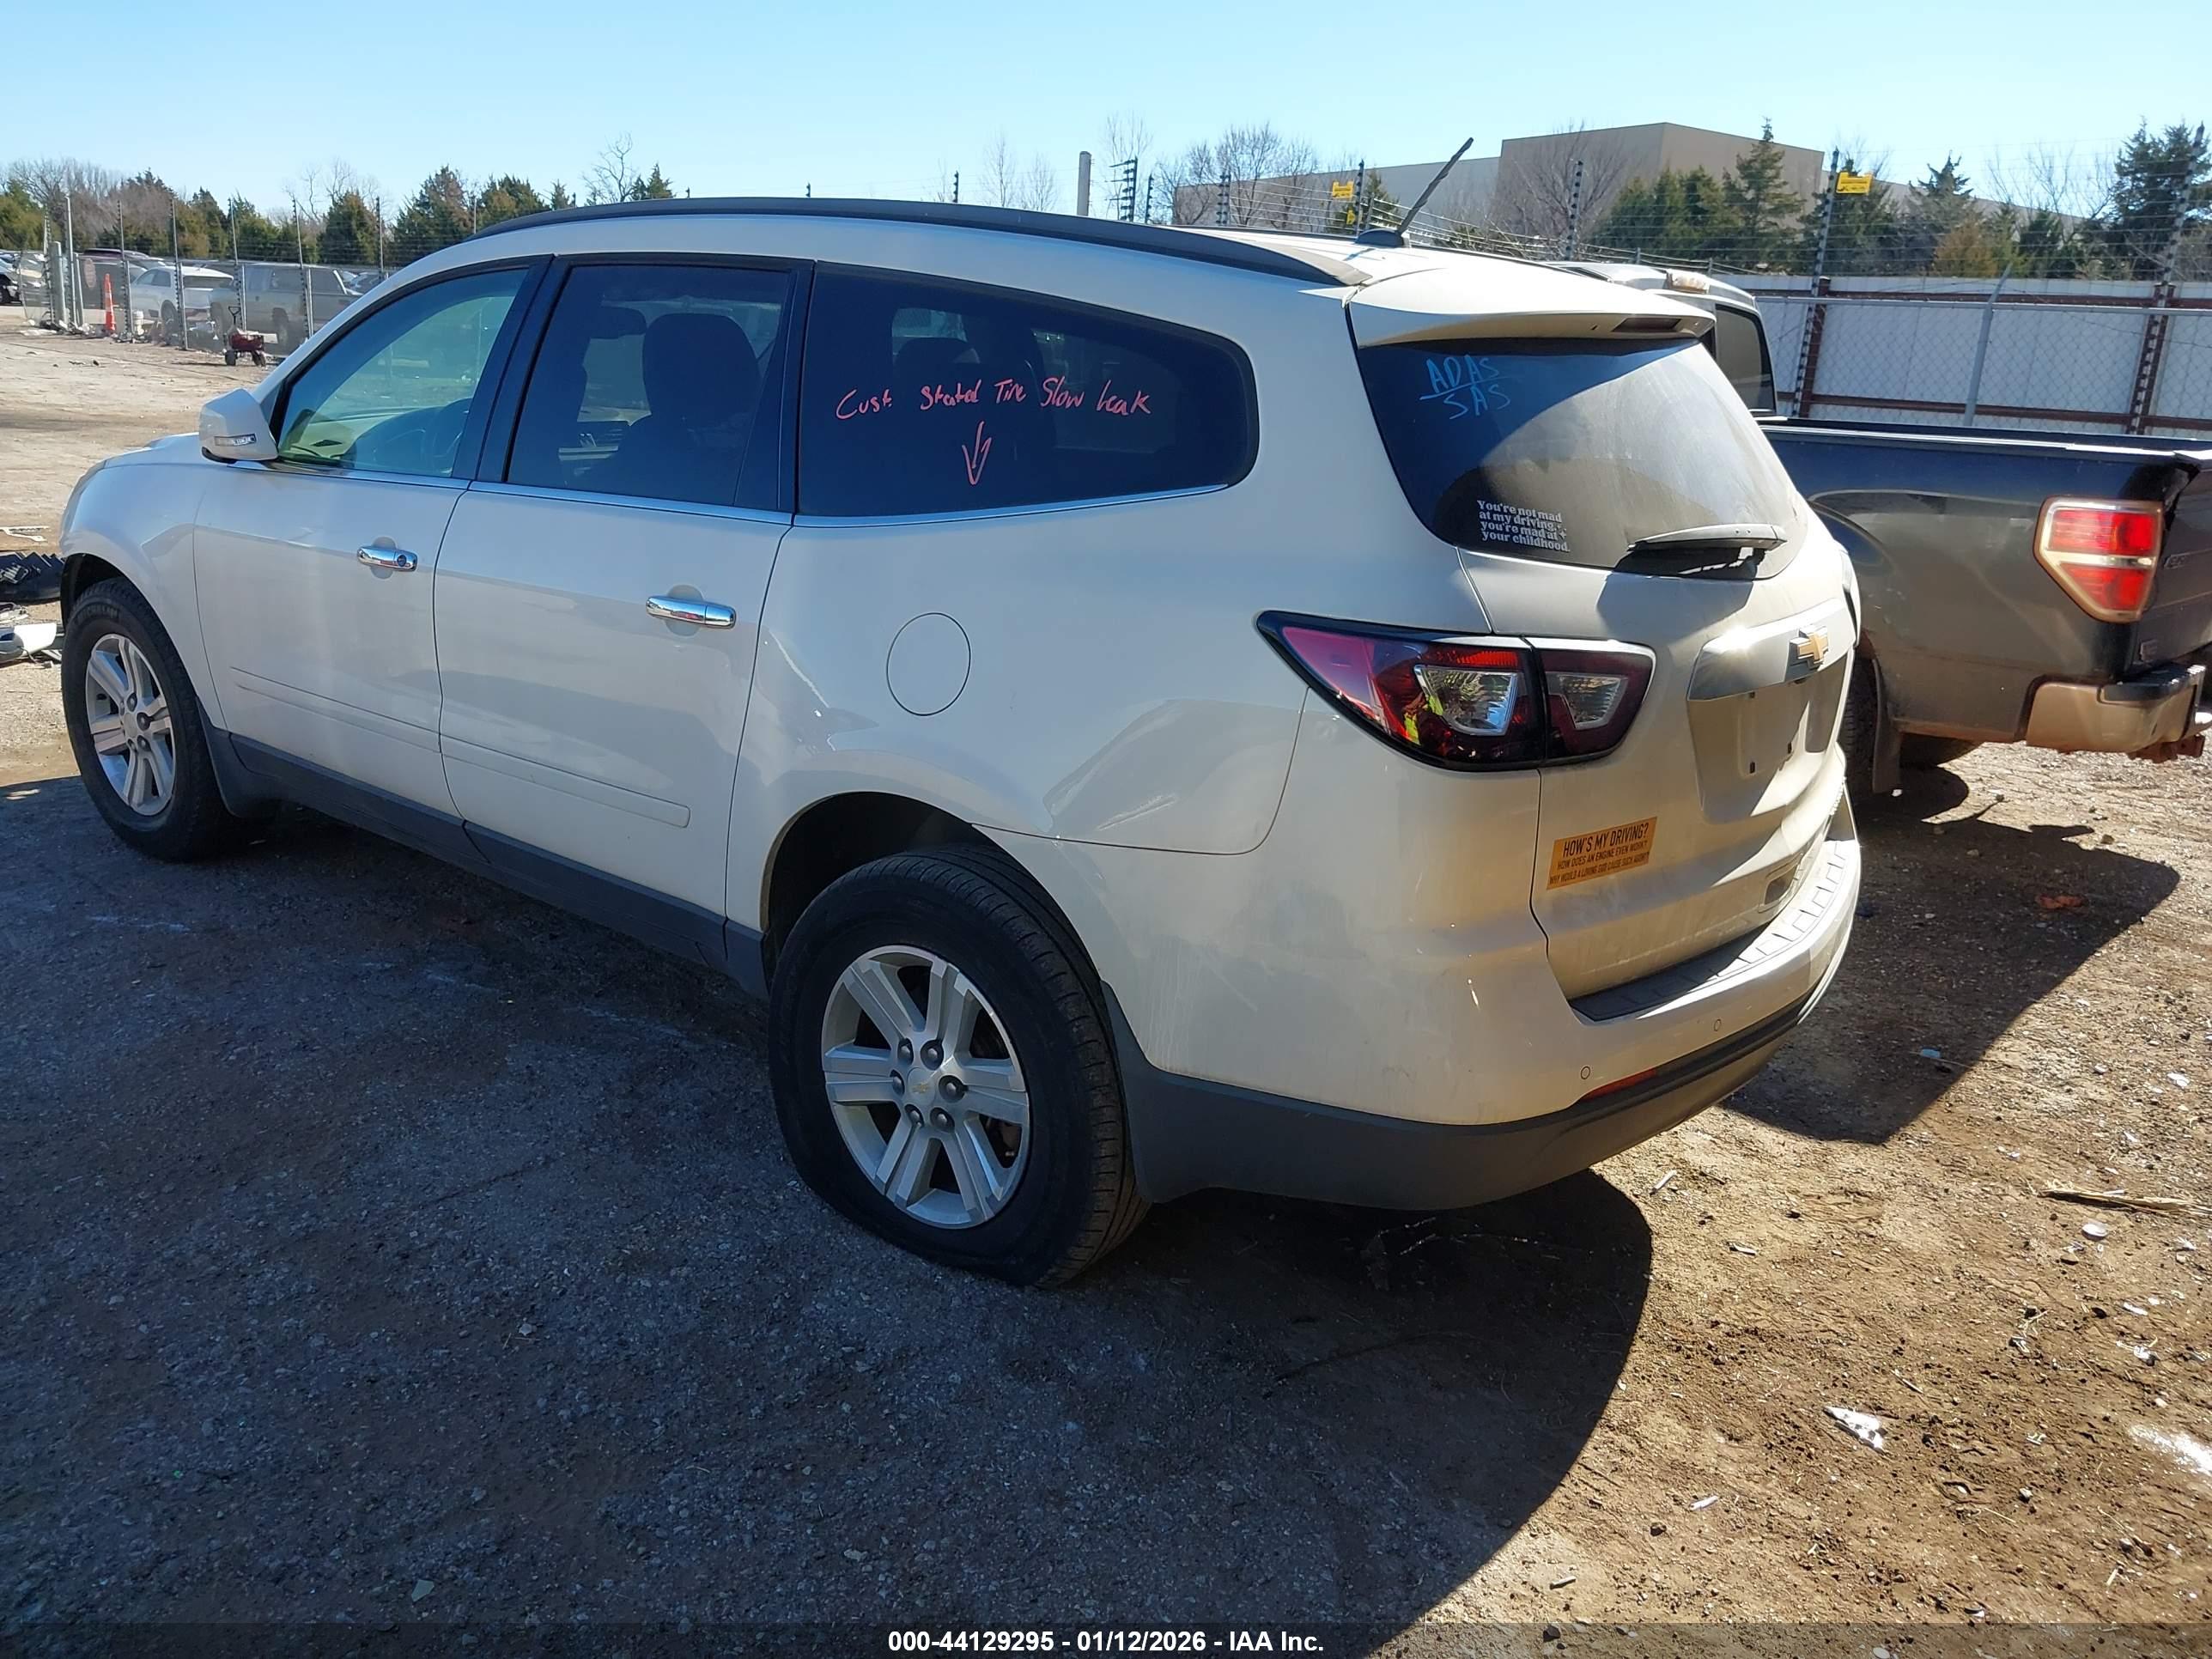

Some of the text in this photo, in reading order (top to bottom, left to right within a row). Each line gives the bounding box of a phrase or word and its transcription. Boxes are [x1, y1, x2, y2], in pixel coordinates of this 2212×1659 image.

[1425, 355, 1500, 393] ADAS
[994, 378, 1028, 404] Tire
[1040, 375, 1085, 408] Slow
[1096, 379, 1152, 416] Leak
[1443, 384, 1511, 420] SAS
[1477, 500, 1562, 523] You're not mad
[1479, 511, 1492, 520] at
[1492, 514, 1511, 525] my
[1480, 521, 1559, 541] you're mad at
[1481, 531, 1510, 542] your
[1563, 823, 1650, 858] HOW'S MY DRIVING?
[1557, 859, 1571, 870] HOW
[1571, 855, 1587, 867] DOES
[1587, 853, 1595, 863] AN
[1595, 848, 1614, 861] ENGINE
[1614, 845, 1628, 856] EVEN
